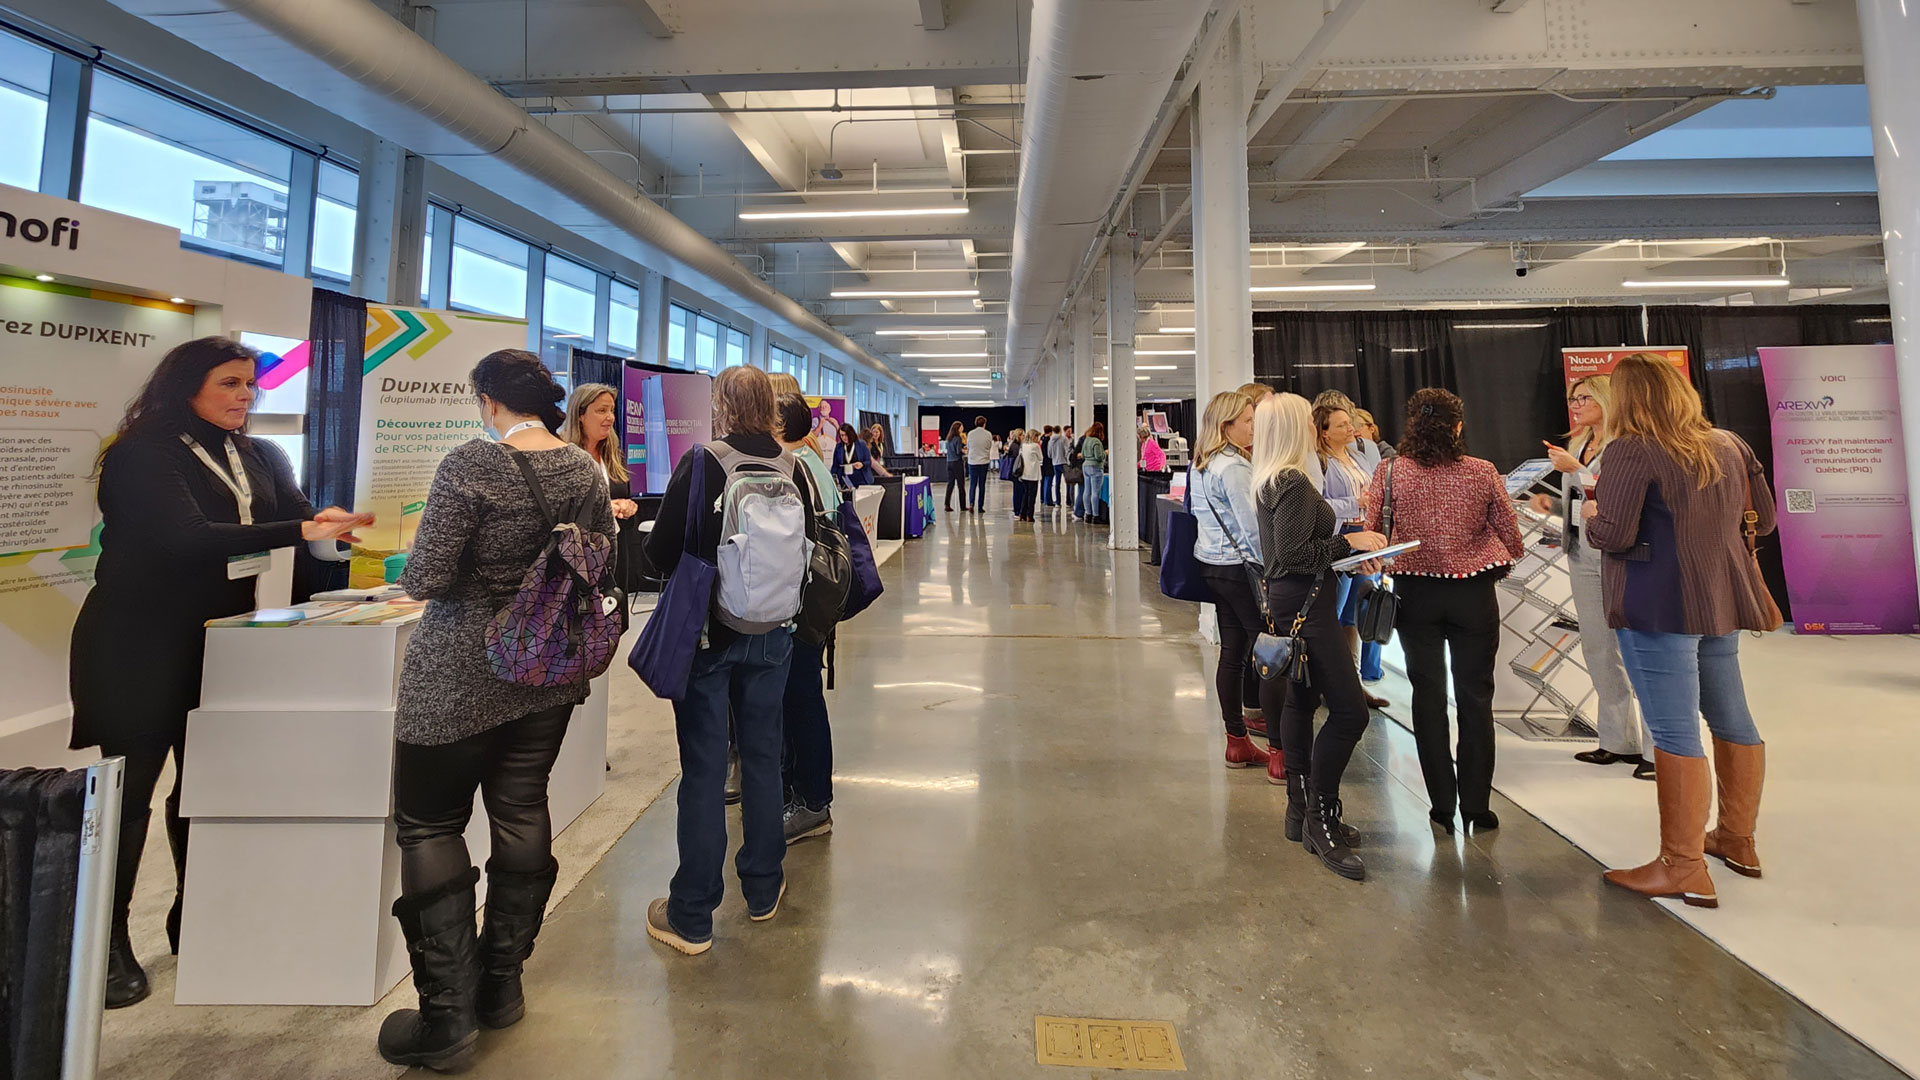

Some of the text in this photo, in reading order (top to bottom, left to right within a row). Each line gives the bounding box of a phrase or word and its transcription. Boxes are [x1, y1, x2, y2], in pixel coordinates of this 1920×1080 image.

[0, 319, 33, 335] ez
[1568, 355, 1605, 365] NUCALA
[35, 397, 72, 408] sévère
[74, 400, 98, 409] avec
[380, 394, 437, 406] (dupilumab
[1776, 400, 1829, 410] AREXVY
[21, 409, 60, 418] nasaux
[376, 419, 441, 429] Découvrez
[38, 436, 52, 444] des
[375, 432, 400, 441] Pour
[426, 432, 469, 442] patients
[1844, 437, 1894, 445] maintenant
[375, 445, 389, 453] de
[392, 444, 432, 453] RSC-PN
[1827, 447, 1839, 455] du
[11, 464, 56, 472] d'entretien
[1850, 466, 1873, 474] (PIQ)
[11, 474, 45, 482] patients
[47, 472, 75, 480] adultes
[12, 482, 63, 490] rhinosinusite
[44, 491, 74, 499] polypes
[19, 501, 32, 509] qui
[20, 528, 42, 536] et/ou
